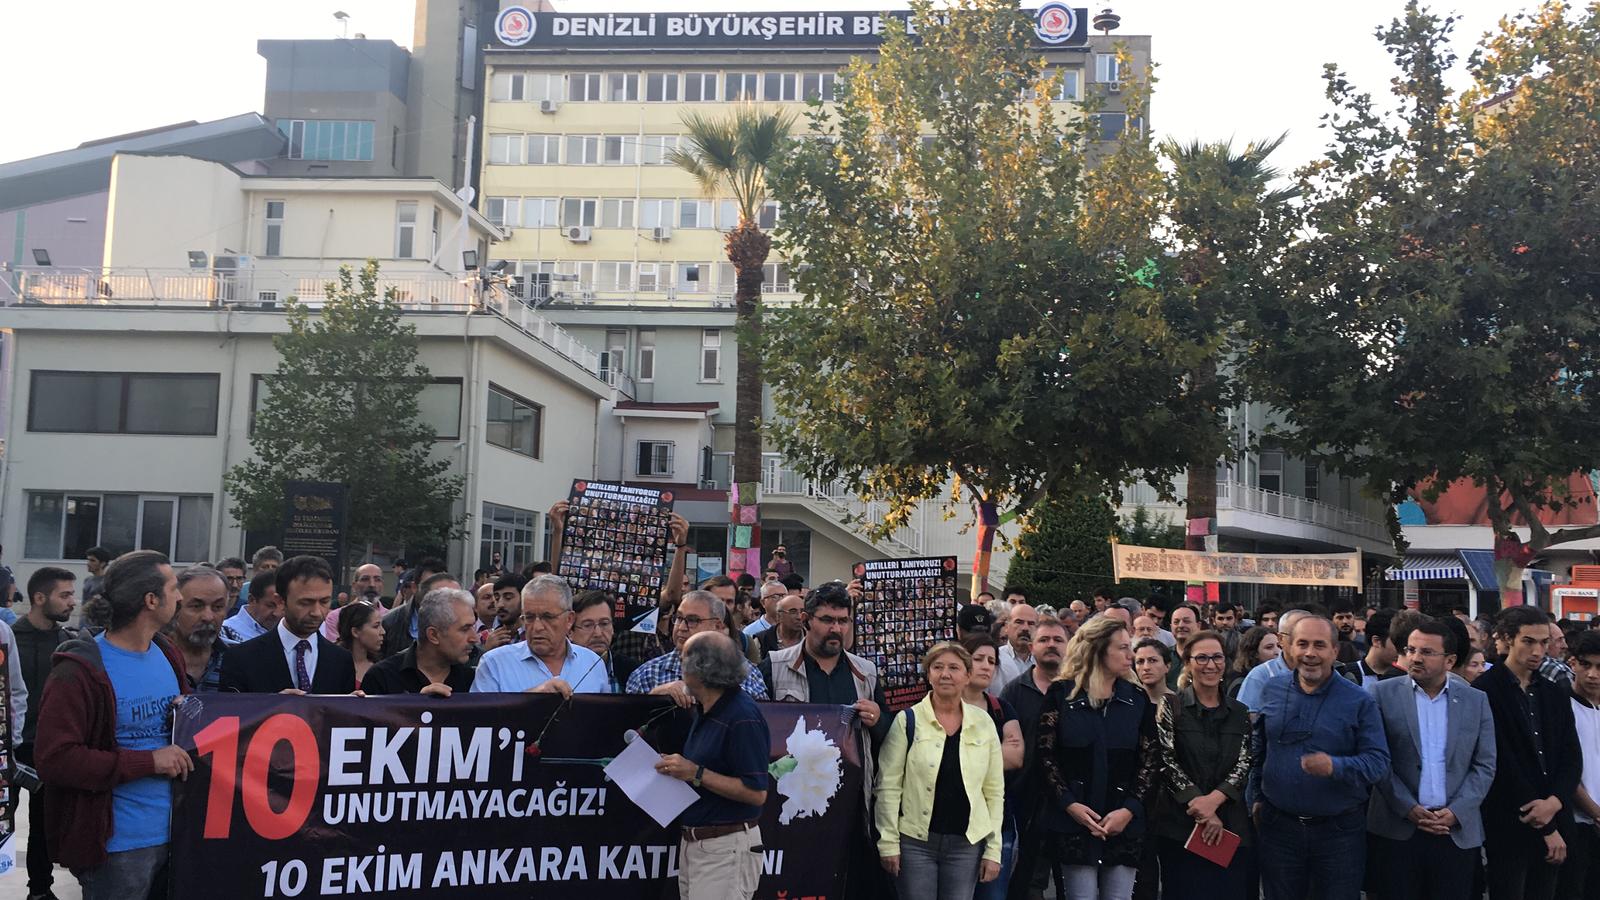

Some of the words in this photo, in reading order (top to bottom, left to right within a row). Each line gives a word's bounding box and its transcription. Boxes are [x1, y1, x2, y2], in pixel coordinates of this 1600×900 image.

[552, 13, 656, 36] DENİZLİ
[667, 12, 845, 40] BÜYÜKŞEHİR
[584, 489, 659, 505] UNUTTURMAYACAĞIZ!
[620, 485, 661, 498] TANIYORUZ!
[866, 568, 941, 580] UNUTTURMAYACAĞIZ!
[901, 559, 941, 569] TANIYORUZ!
[192, 712, 321, 840] 10
[322, 780, 607, 825] UNUTMAYACAĞIZ!
[260, 858, 308, 898] 10
[320, 844, 423, 896] EKİM
[431, 845, 588, 888] ANKARA
